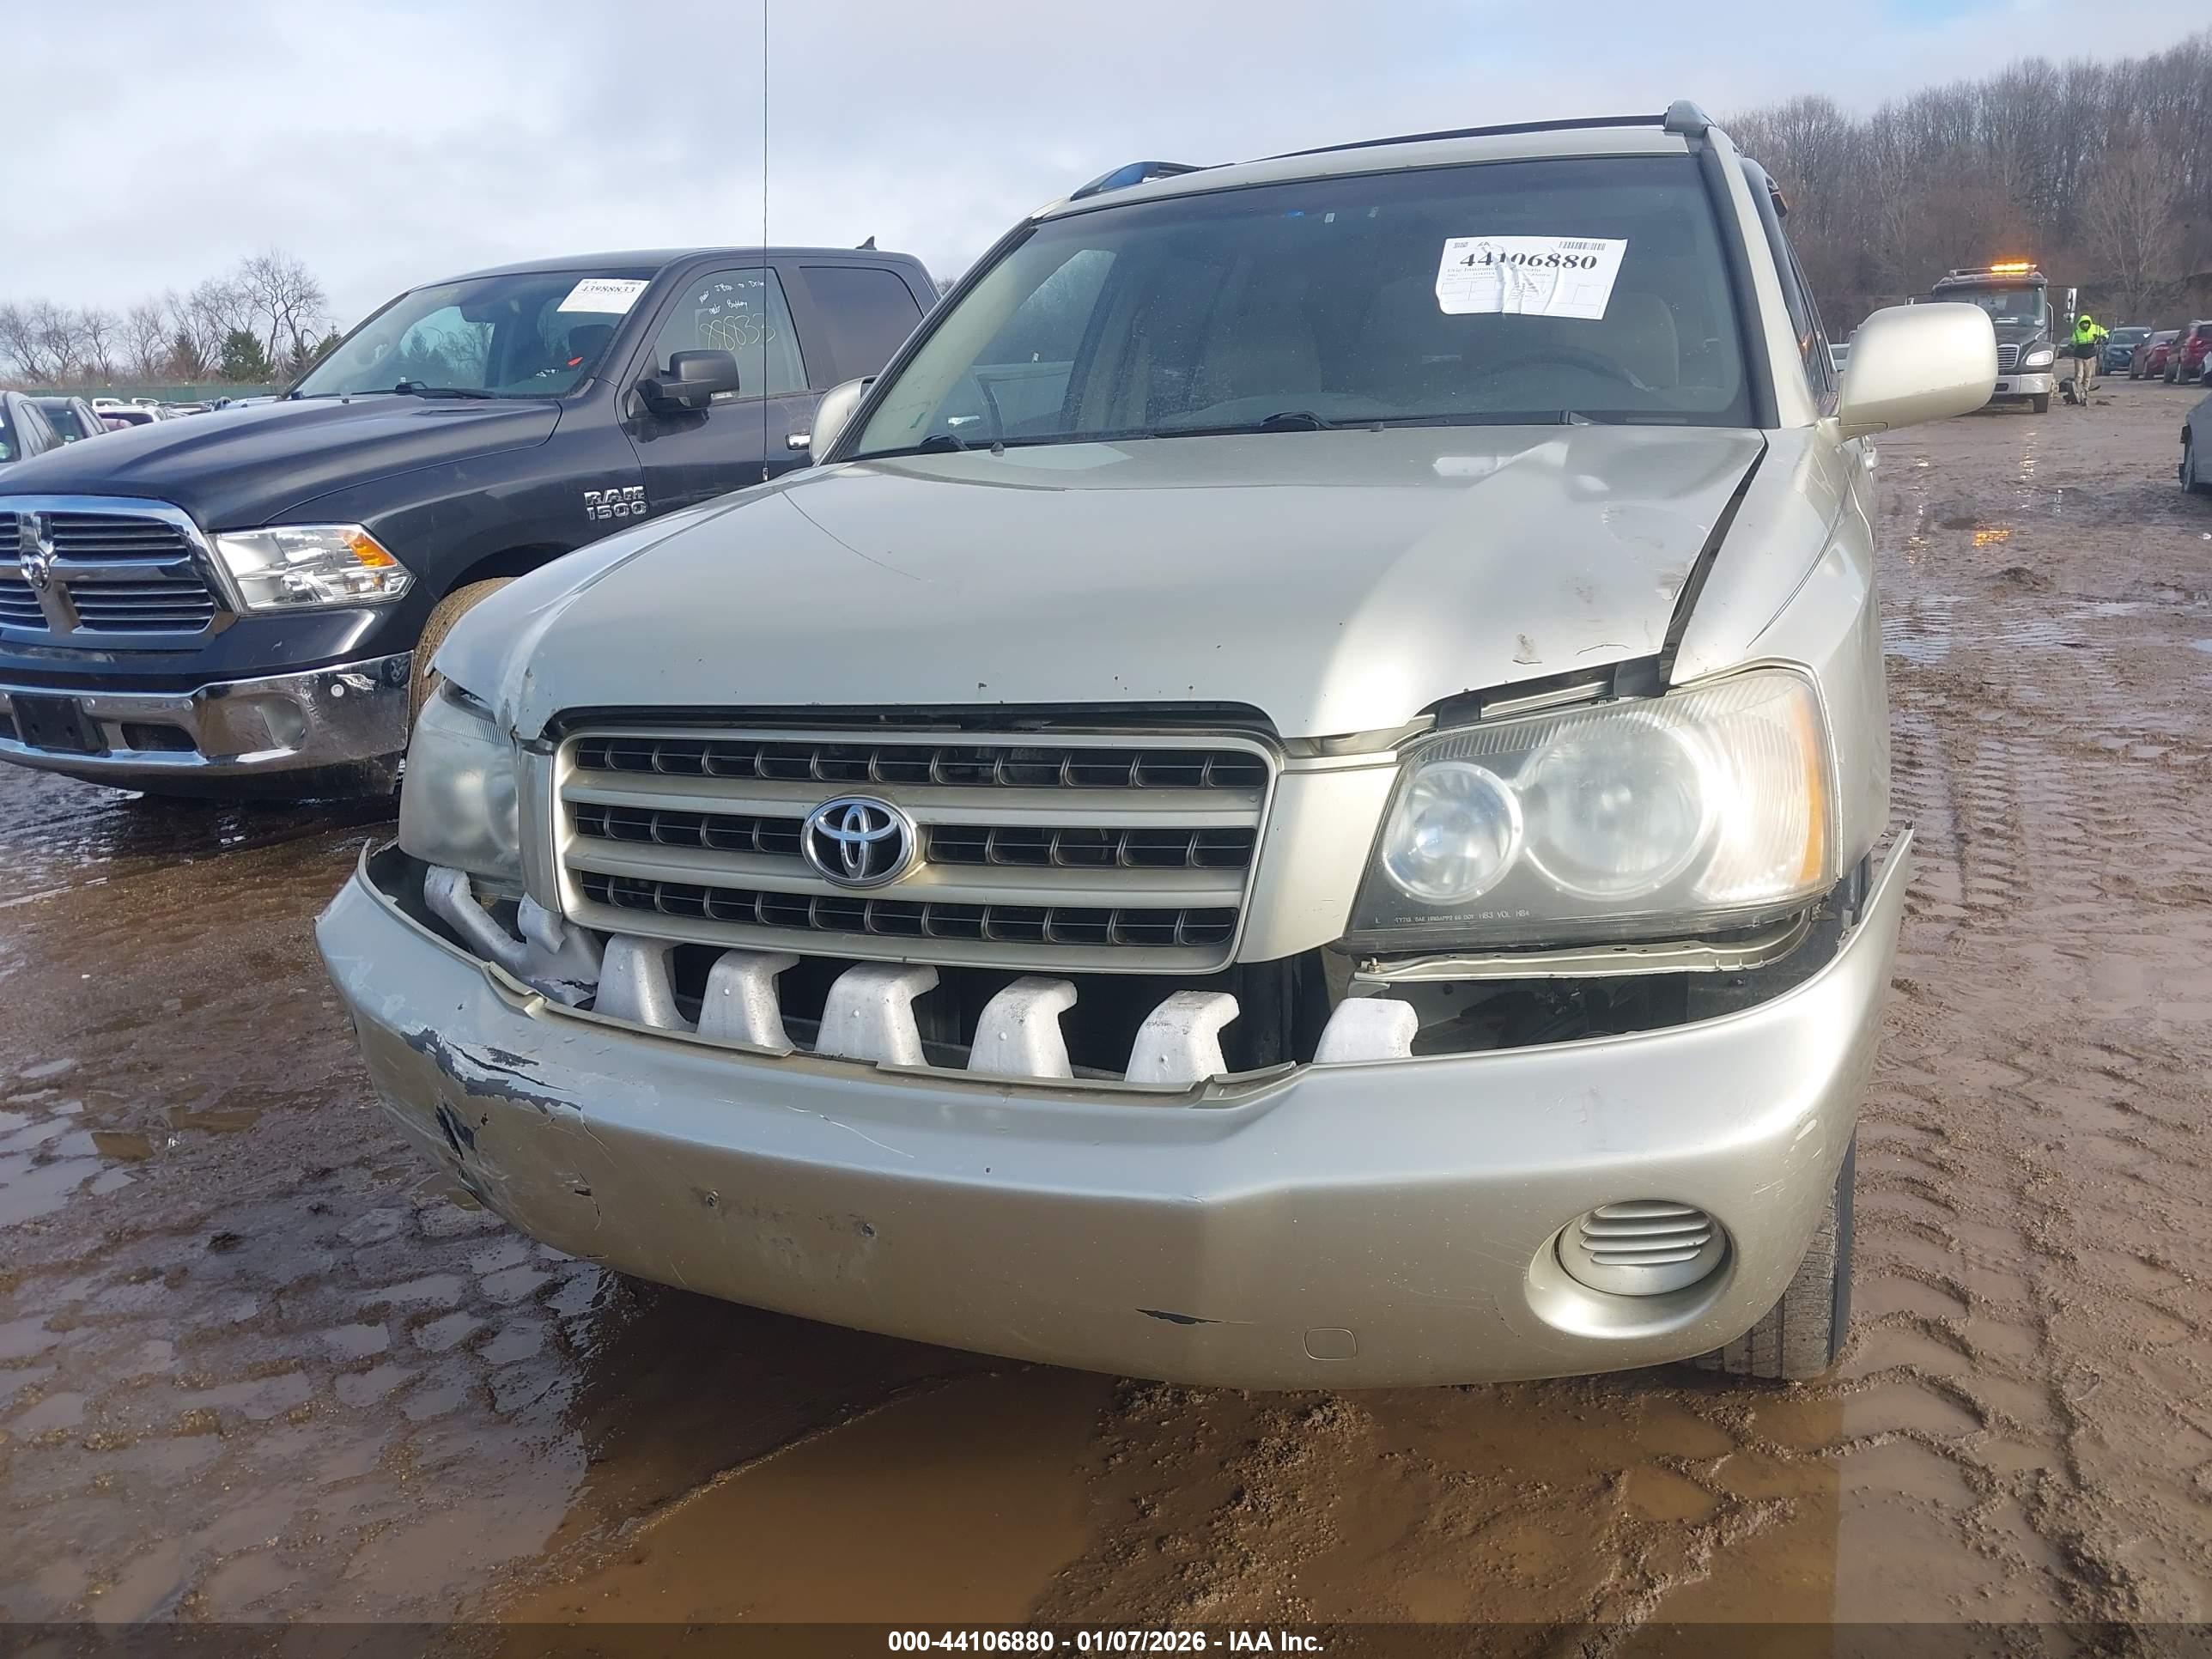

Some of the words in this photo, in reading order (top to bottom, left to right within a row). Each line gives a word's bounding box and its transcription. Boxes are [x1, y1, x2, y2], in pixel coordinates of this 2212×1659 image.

[1459, 252, 1597, 270] 44106880
[584, 485, 645, 506] RAM
[586, 501, 647, 520] 1500
